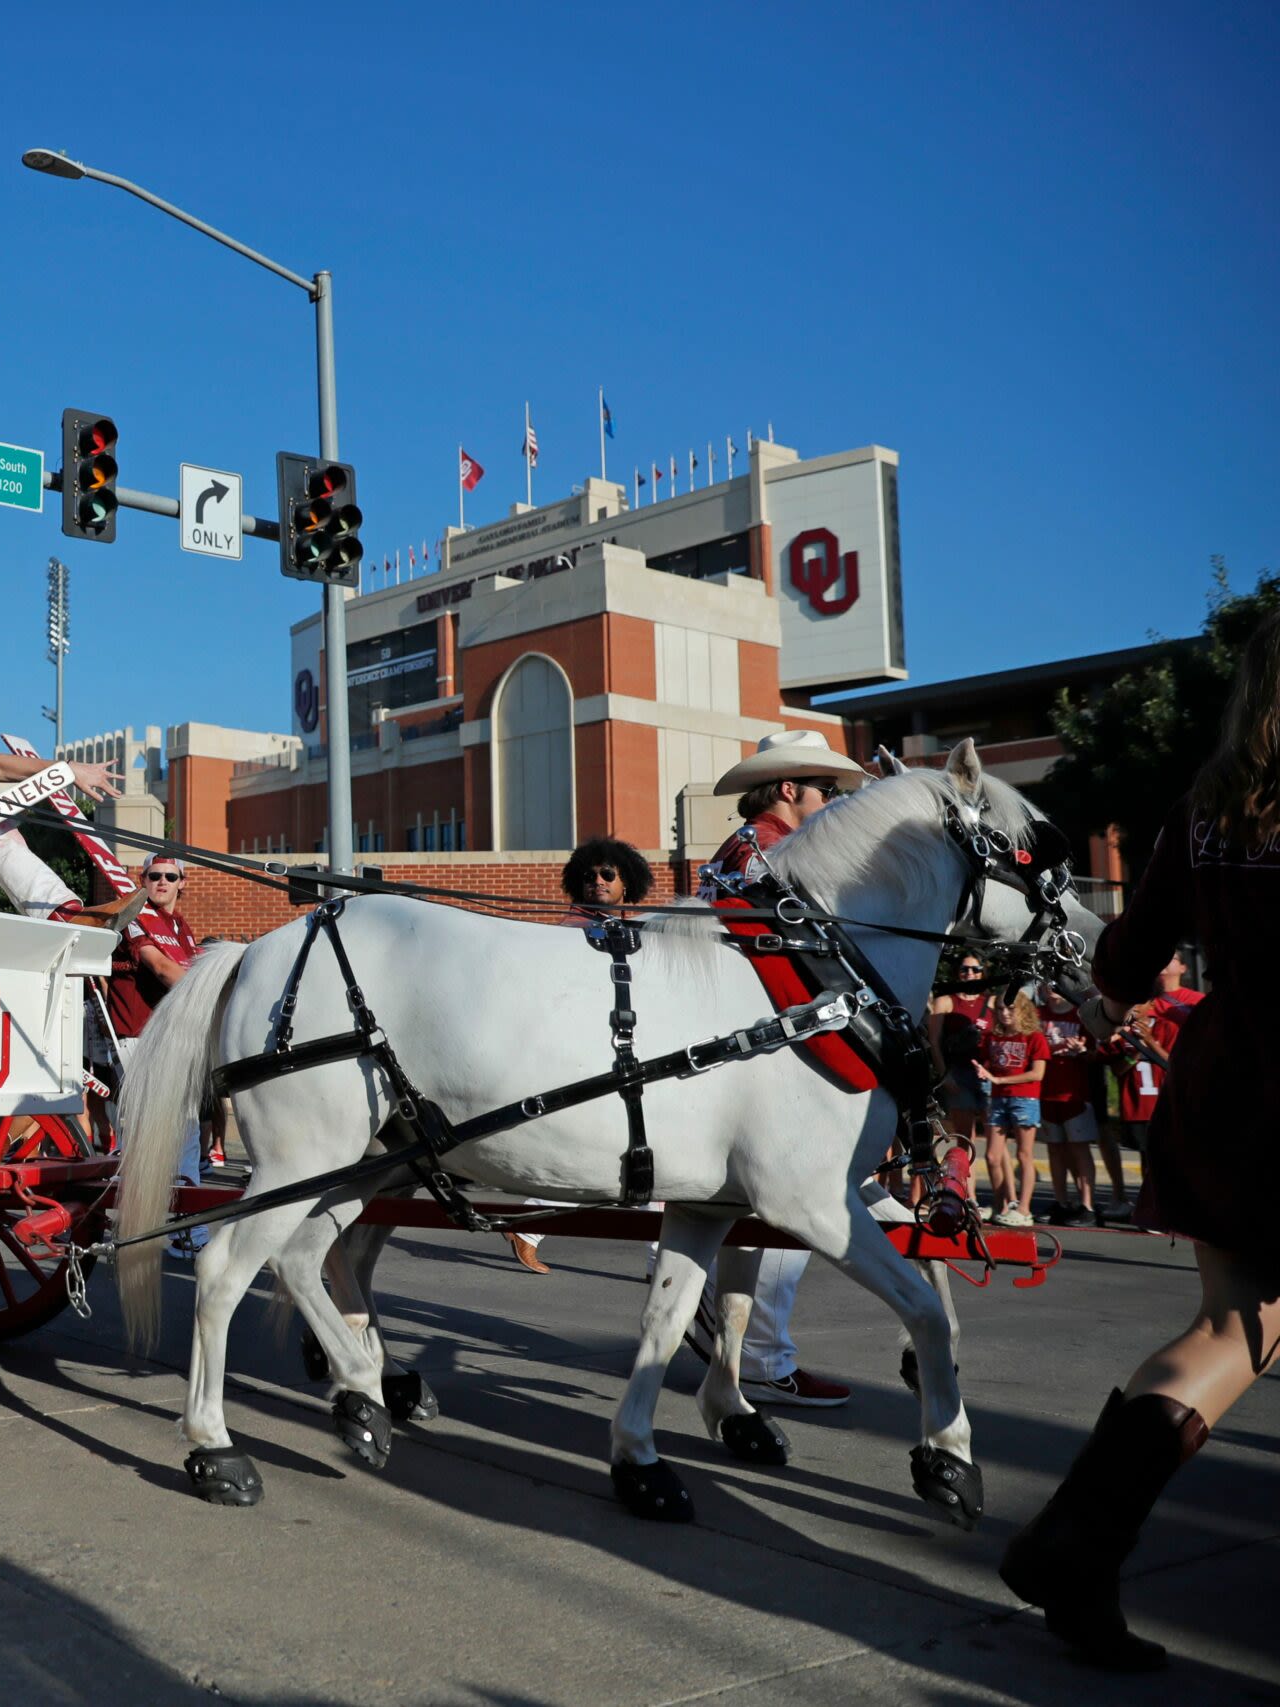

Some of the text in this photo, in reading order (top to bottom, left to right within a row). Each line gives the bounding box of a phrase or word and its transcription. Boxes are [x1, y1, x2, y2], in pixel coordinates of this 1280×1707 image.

[0, 458, 27, 475] South
[0, 479, 23, 494] 1200
[192, 528, 234, 550] ONLY
[788, 527, 860, 616] OU
[295, 669, 319, 733] OU
[93, 853, 138, 894] UF
[1136, 1061, 1159, 1095] 1
